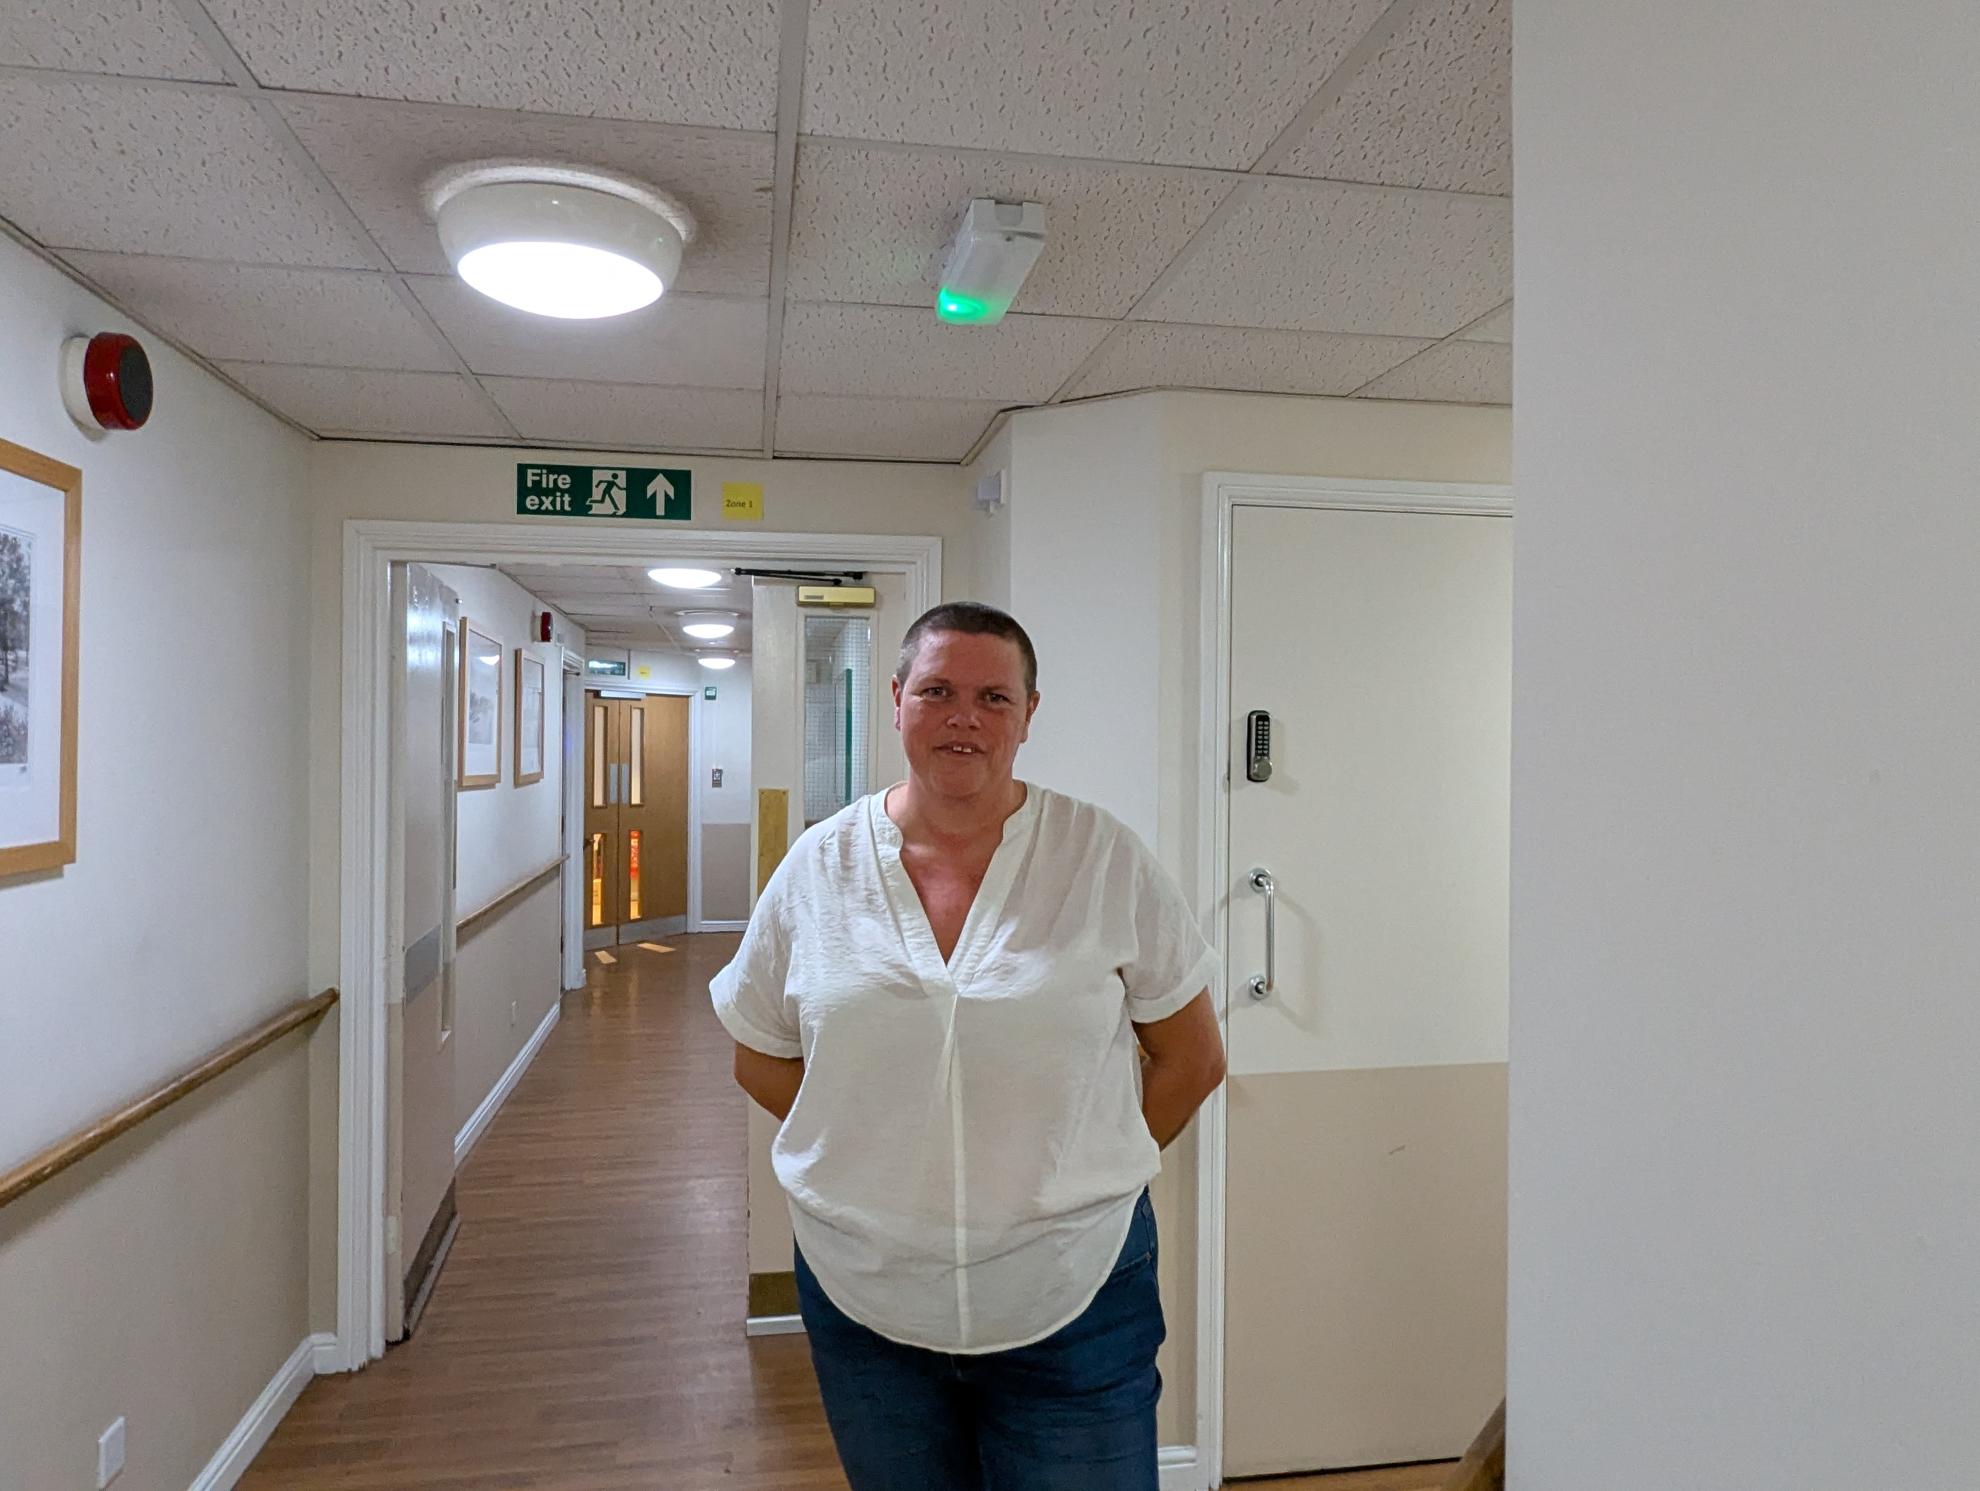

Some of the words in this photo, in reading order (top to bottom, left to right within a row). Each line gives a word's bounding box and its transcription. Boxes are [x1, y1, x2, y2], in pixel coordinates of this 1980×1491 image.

[526, 468, 572, 489] Fire
[525, 492, 572, 511] exit
[726, 499, 746, 508] Zone
